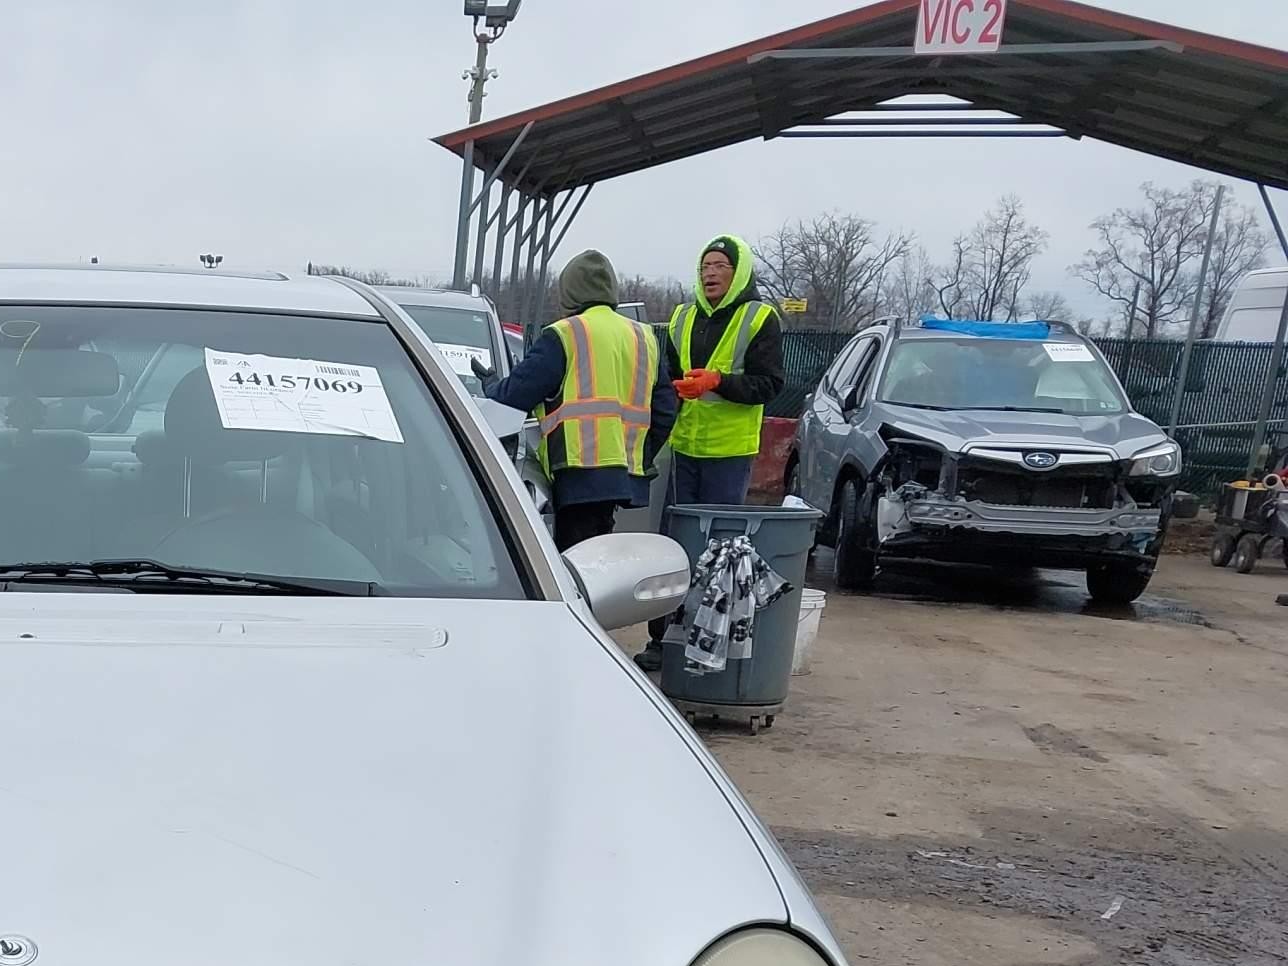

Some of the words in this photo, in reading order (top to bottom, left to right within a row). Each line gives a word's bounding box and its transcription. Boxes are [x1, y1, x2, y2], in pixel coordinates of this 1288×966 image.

[922, 0, 974, 45] VIC
[977, 0, 1002, 44] 2
[228, 371, 363, 394] 44157069
